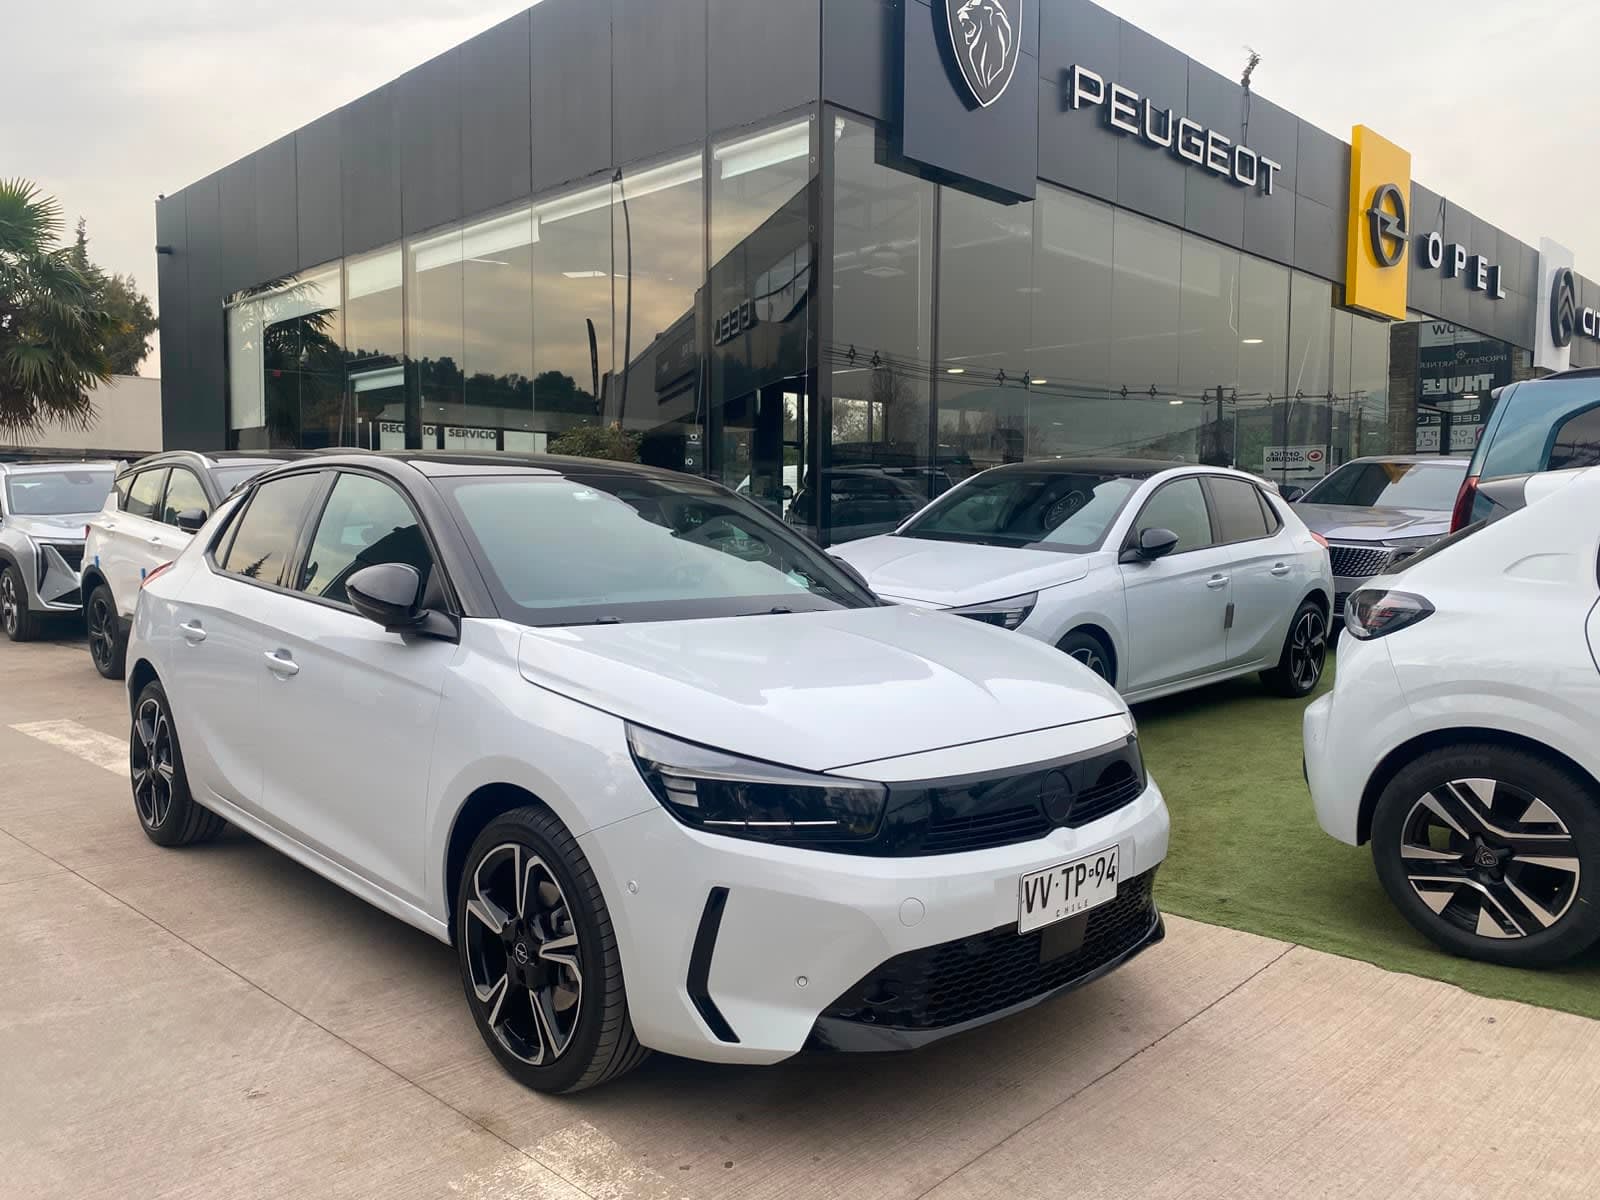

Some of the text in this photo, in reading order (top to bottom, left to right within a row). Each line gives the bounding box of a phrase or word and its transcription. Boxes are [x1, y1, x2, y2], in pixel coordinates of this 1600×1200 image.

[1070, 63, 1281, 195] PEUGEOT
[1426, 231, 1506, 300] OPEL
[448, 428, 497, 440] SERVICIO
[1055, 898, 1089, 918] CHILE
